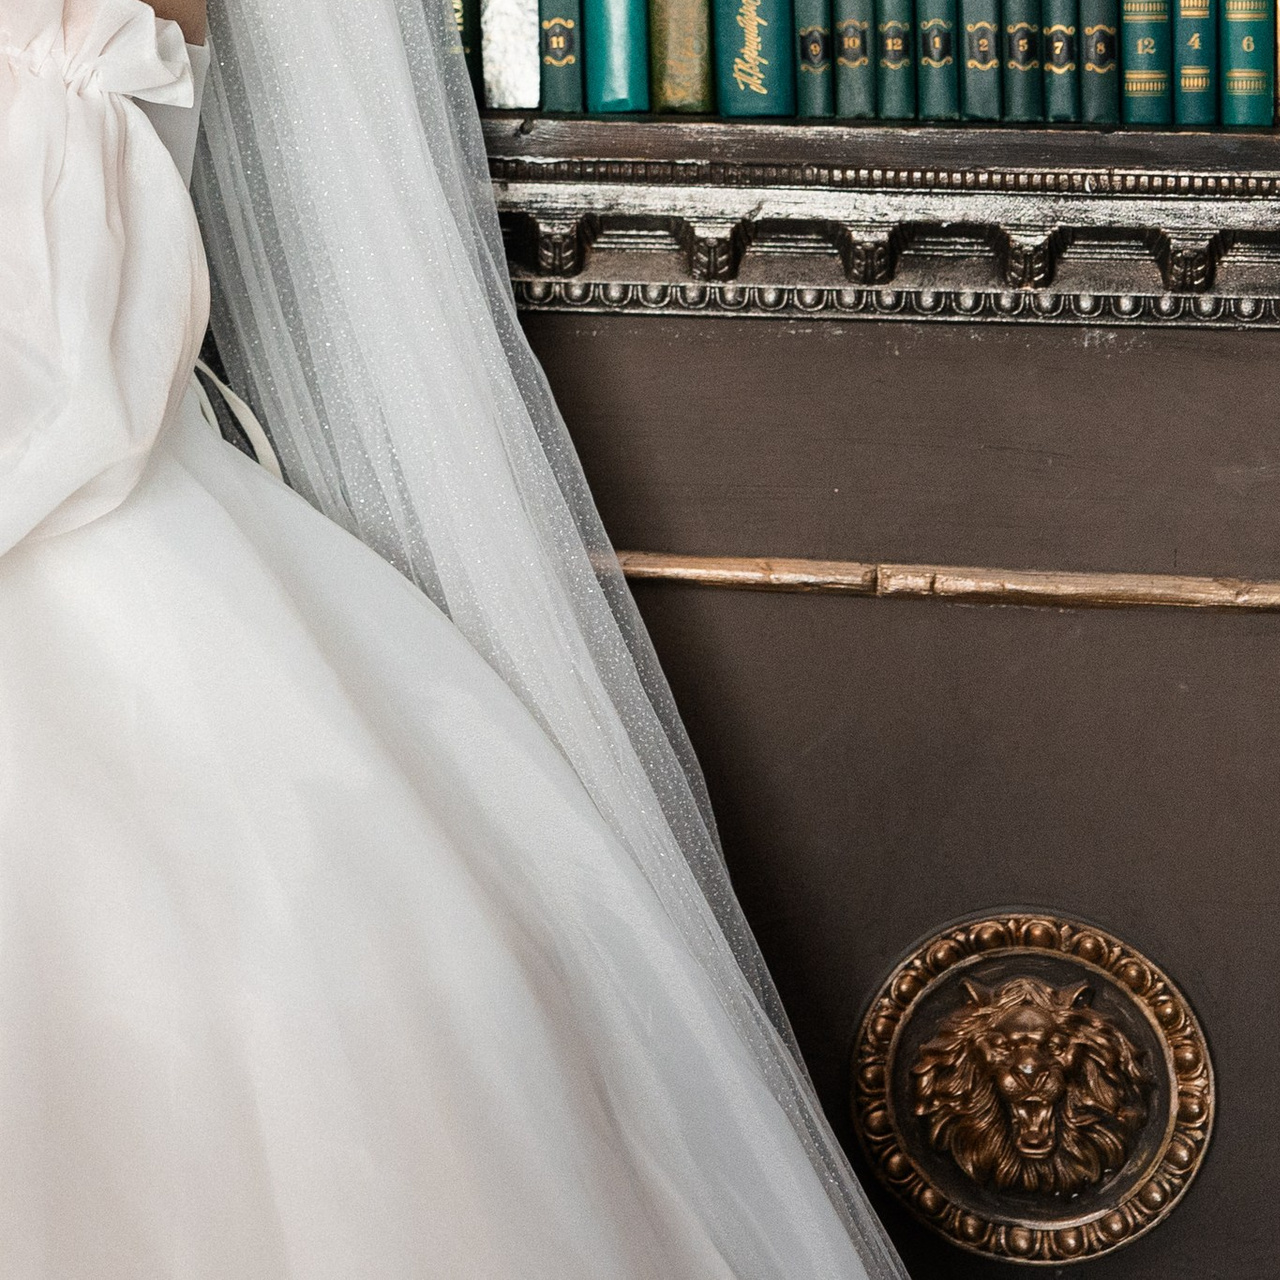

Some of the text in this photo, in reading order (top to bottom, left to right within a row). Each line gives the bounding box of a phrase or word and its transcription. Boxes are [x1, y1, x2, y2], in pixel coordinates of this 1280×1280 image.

[843, 36, 860, 49] 10
[886, 38, 903, 51] 12
[933, 36, 941, 49] 1
[978, 38, 990, 52] 2
[1018, 39, 1029, 53] 5
[1053, 40, 1064, 55] 7
[1096, 42, 1106, 55] 8
[1135, 37, 1156, 55] 12
[1186, 34, 1202, 51] 4
[1241, 36, 1255, 53] 6
